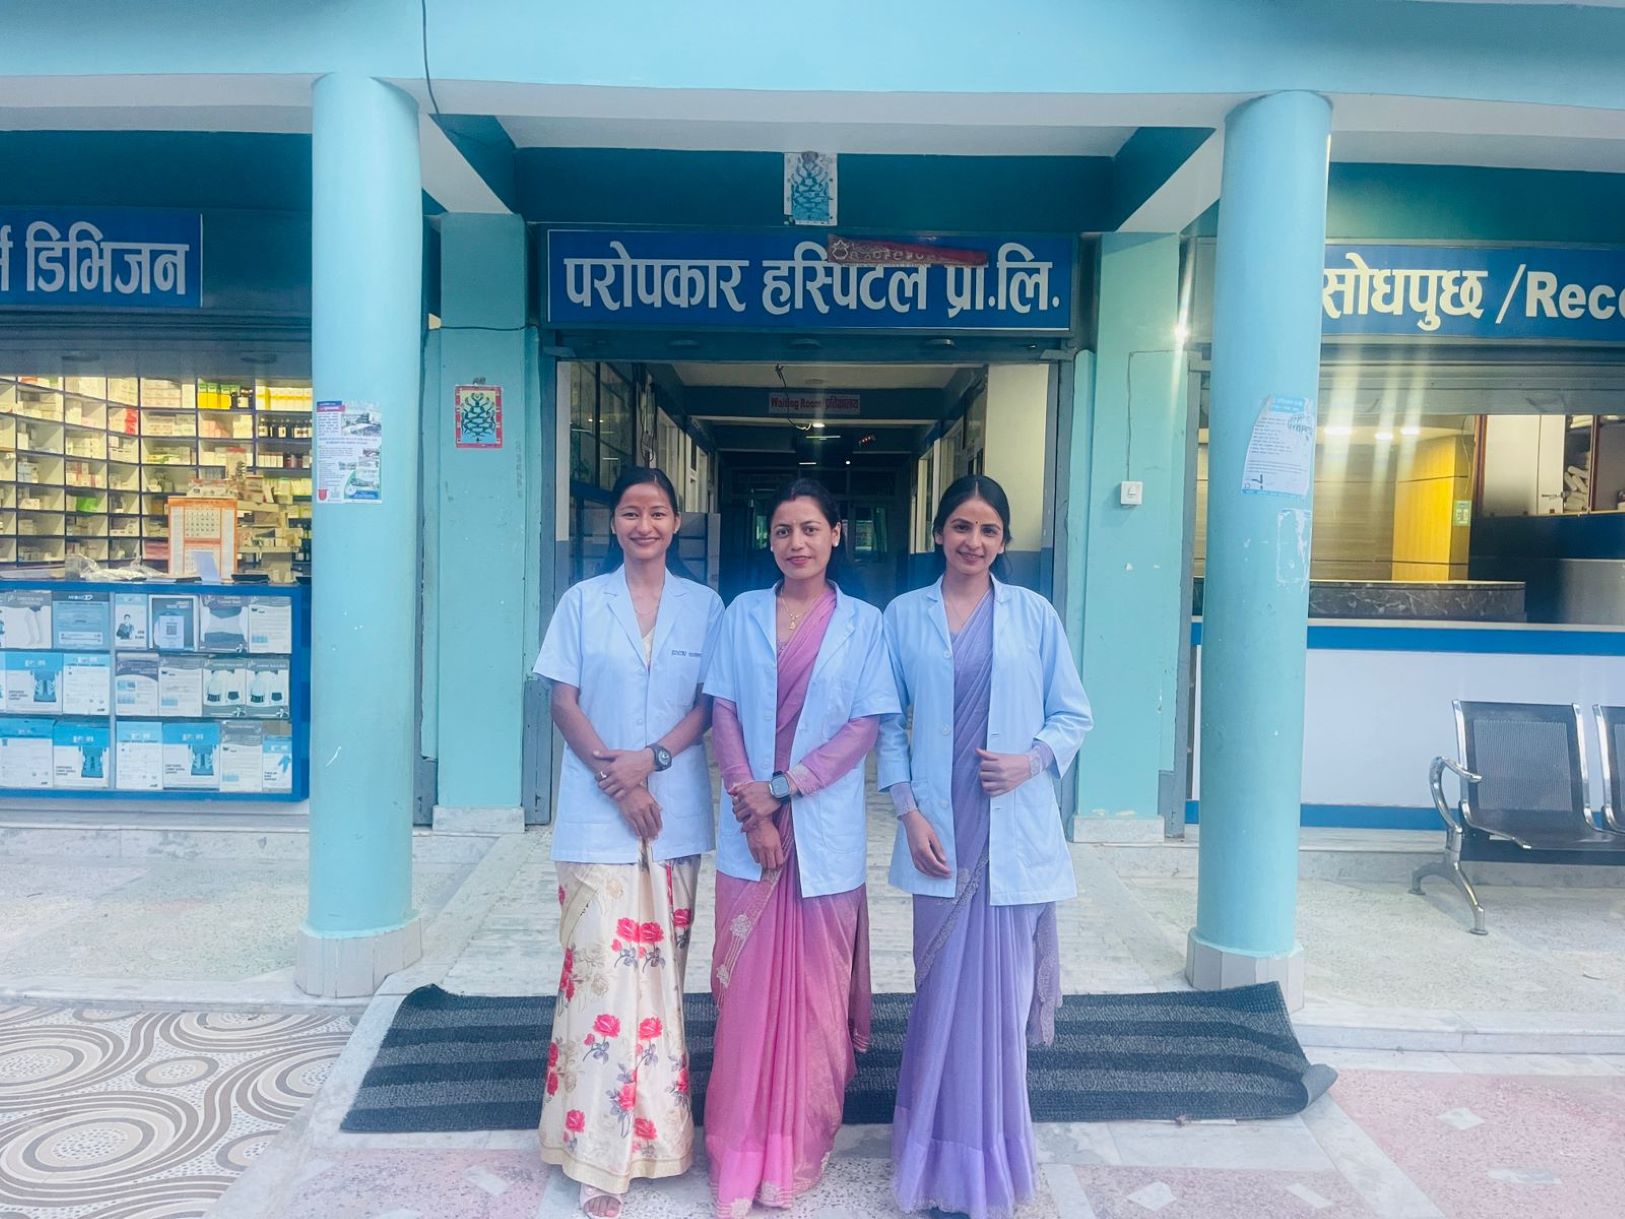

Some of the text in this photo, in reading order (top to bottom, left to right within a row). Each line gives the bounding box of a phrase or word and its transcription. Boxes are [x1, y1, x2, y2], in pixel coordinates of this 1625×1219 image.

[25, 220, 190, 295] डिभिजन
[563, 240, 750, 312] परोपकार
[761, 241, 928, 314] हस्पिटल
[1322, 252, 1625, 331] सोधपुछ /Rec
[771, 397, 800, 410] Waiting
